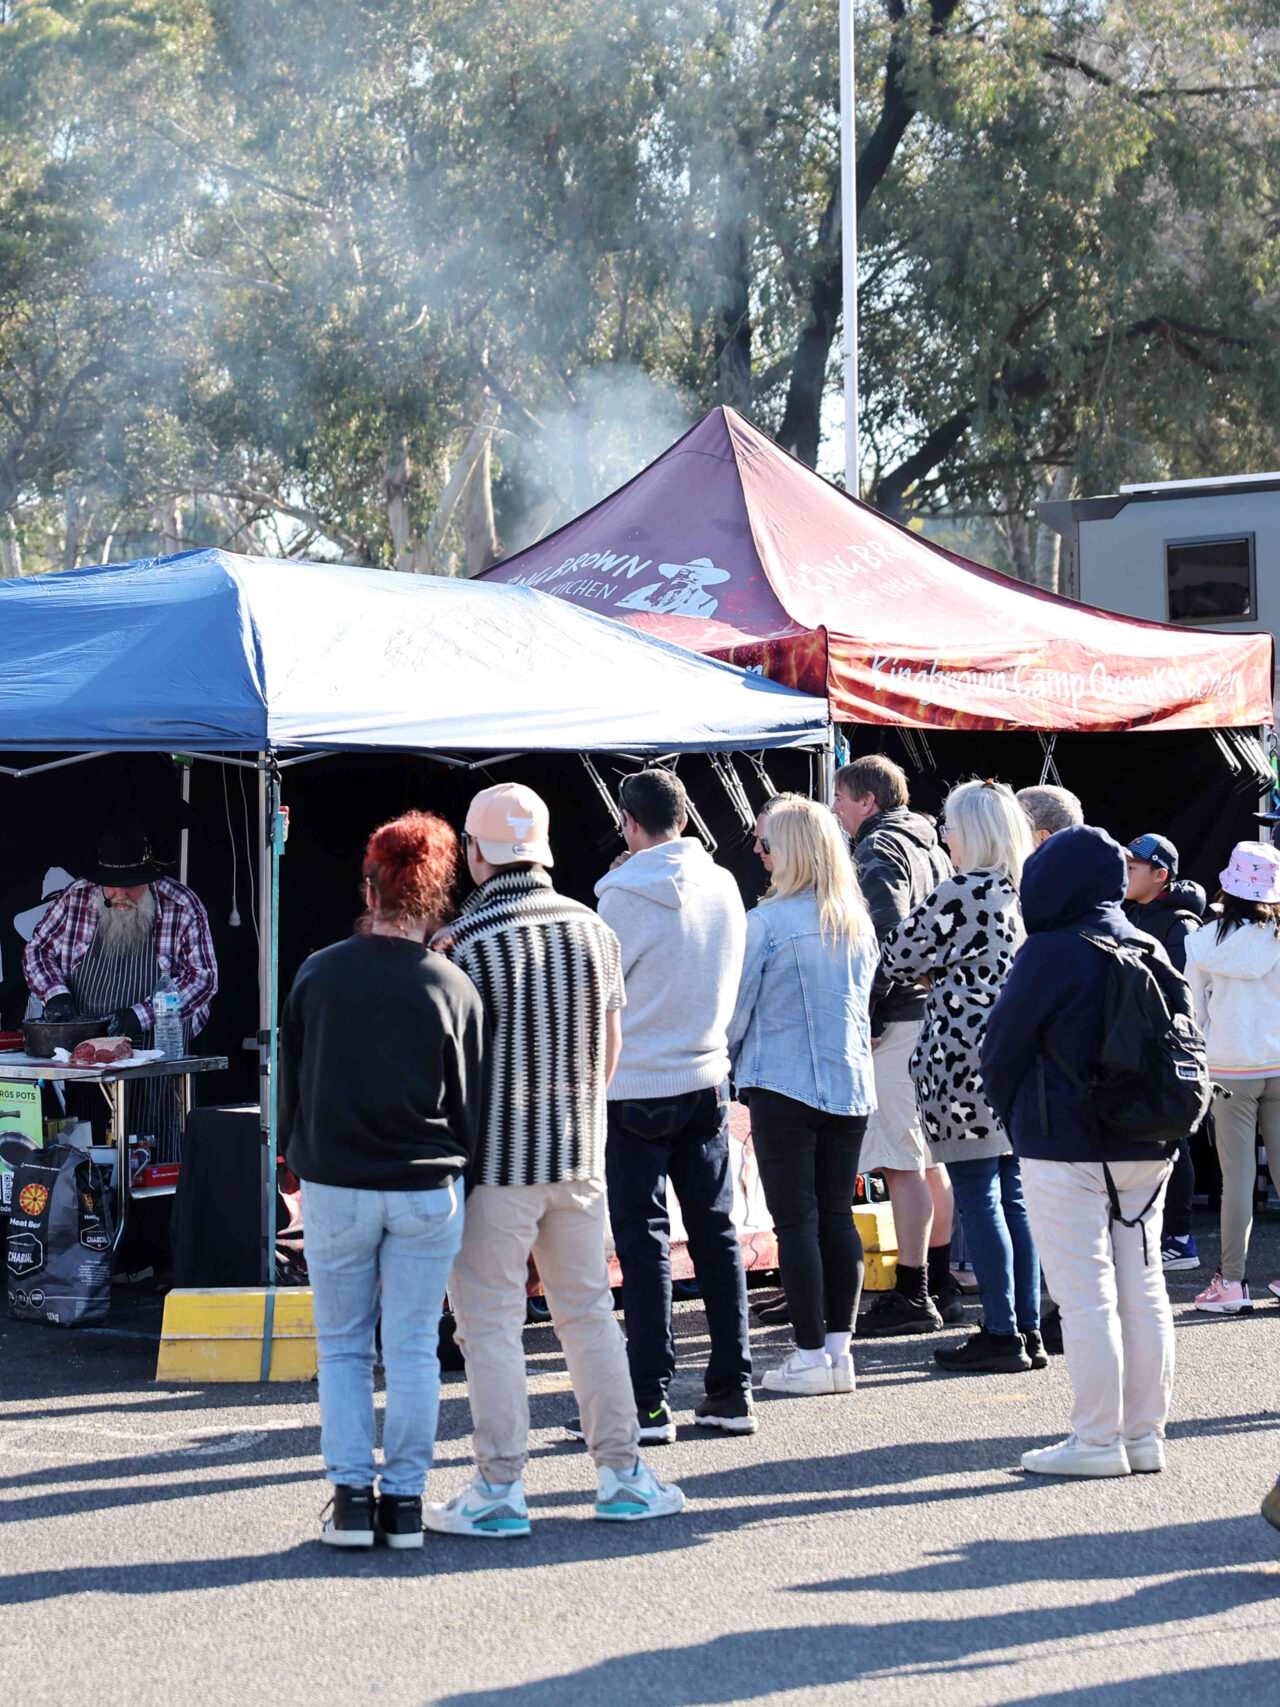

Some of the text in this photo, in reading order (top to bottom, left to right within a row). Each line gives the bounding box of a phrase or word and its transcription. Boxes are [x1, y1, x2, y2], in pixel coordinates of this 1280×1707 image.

[543, 549, 653, 583] BROWN
[871, 655, 1008, 706] Kingbrown
[1013, 664, 1085, 714] Camp
[1089, 661, 1152, 700] Oven
[15, 1091, 36, 1100] POTS
